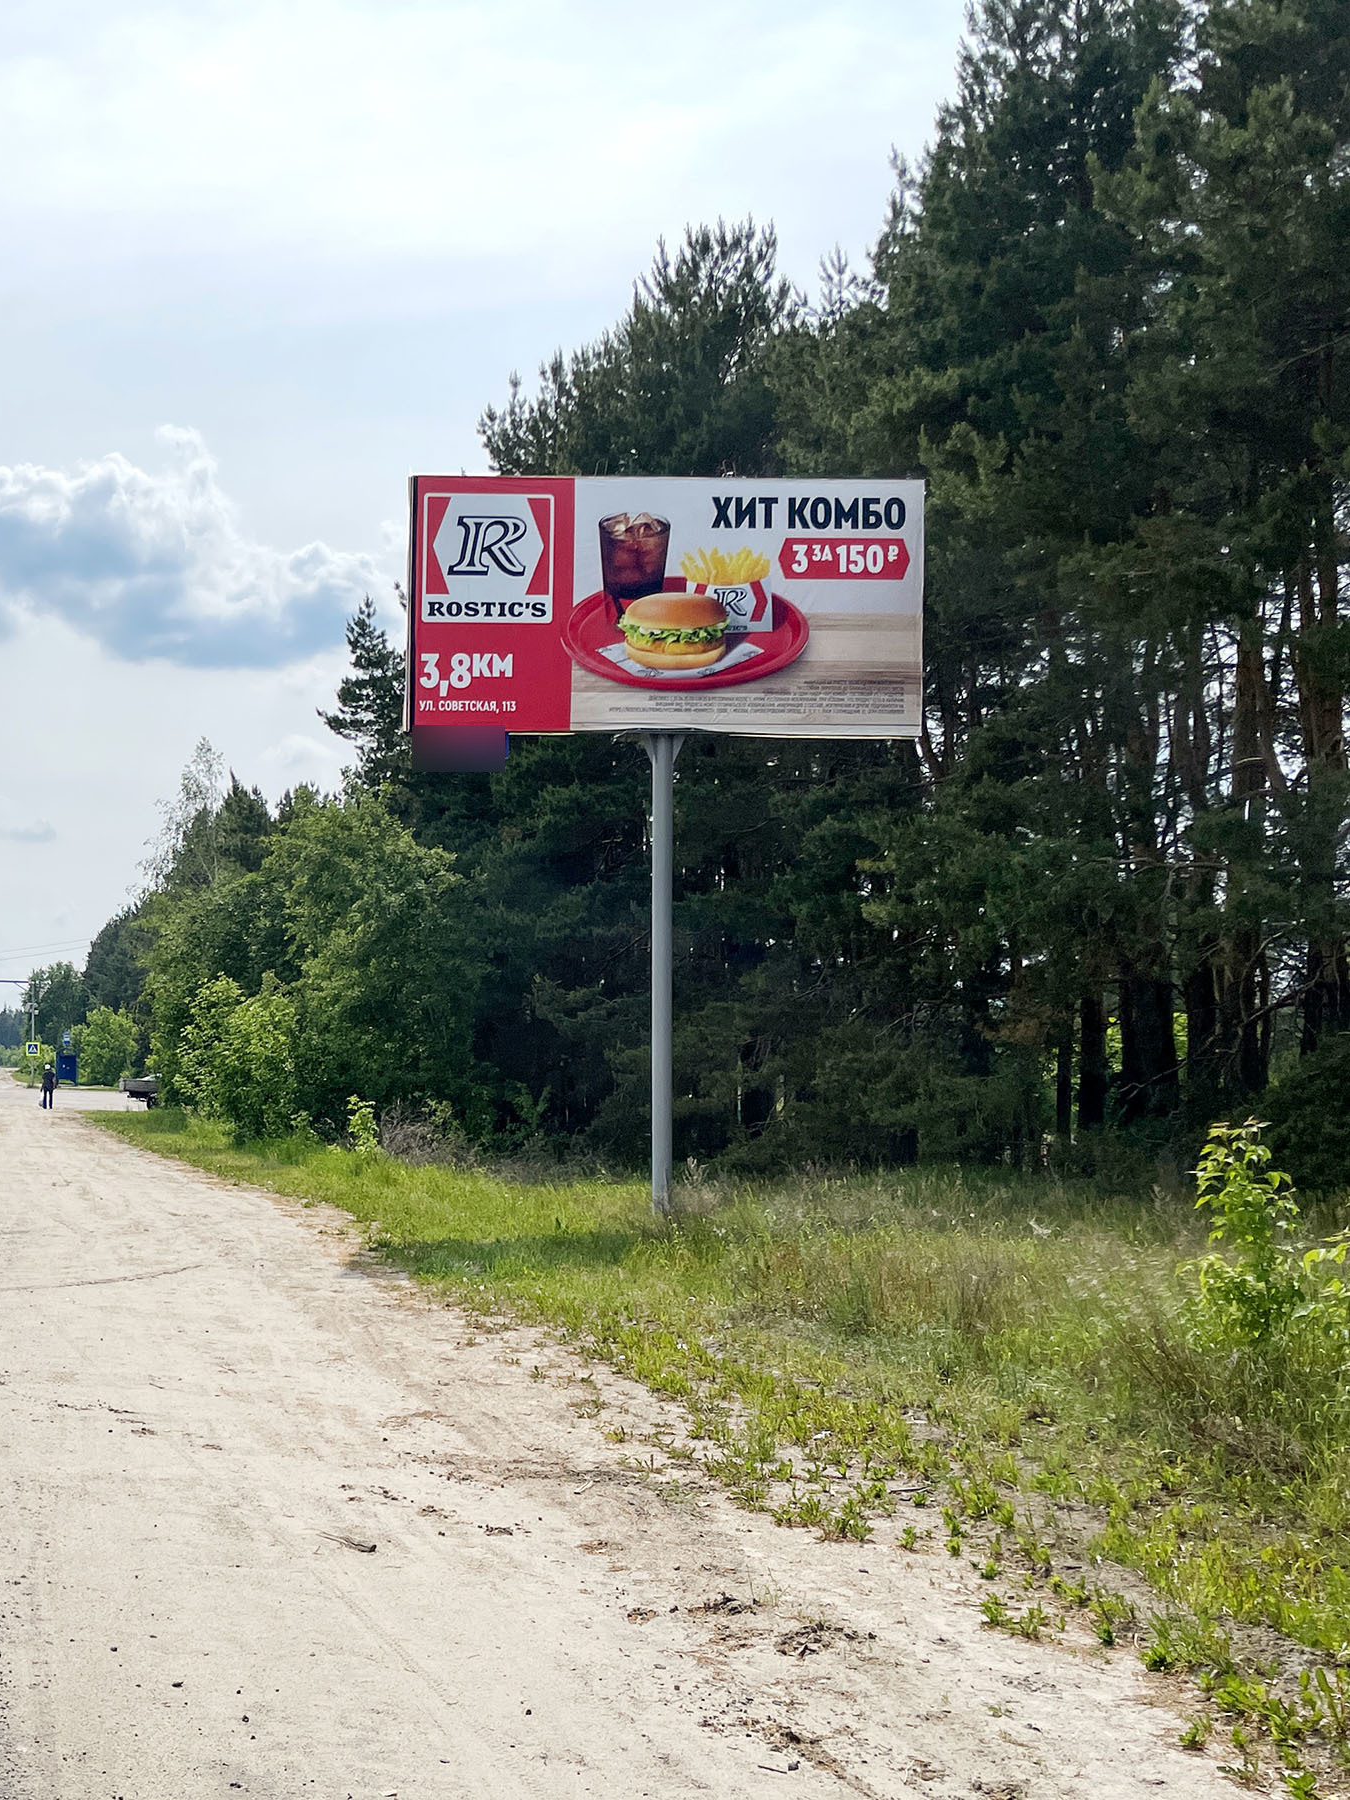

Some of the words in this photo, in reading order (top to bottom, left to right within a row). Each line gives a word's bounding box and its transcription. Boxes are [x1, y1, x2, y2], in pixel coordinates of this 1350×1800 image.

[711, 497, 778, 529] ХИТ
[788, 497, 906, 530] КОМБО
[791, 544, 809, 573] 3
[427, 601, 547, 617] ROSTIC'S
[419, 701, 436, 711] УЛ.
[438, 701, 500, 714] СОВЕТСКАЯ,
[502, 701, 516, 711] 113
